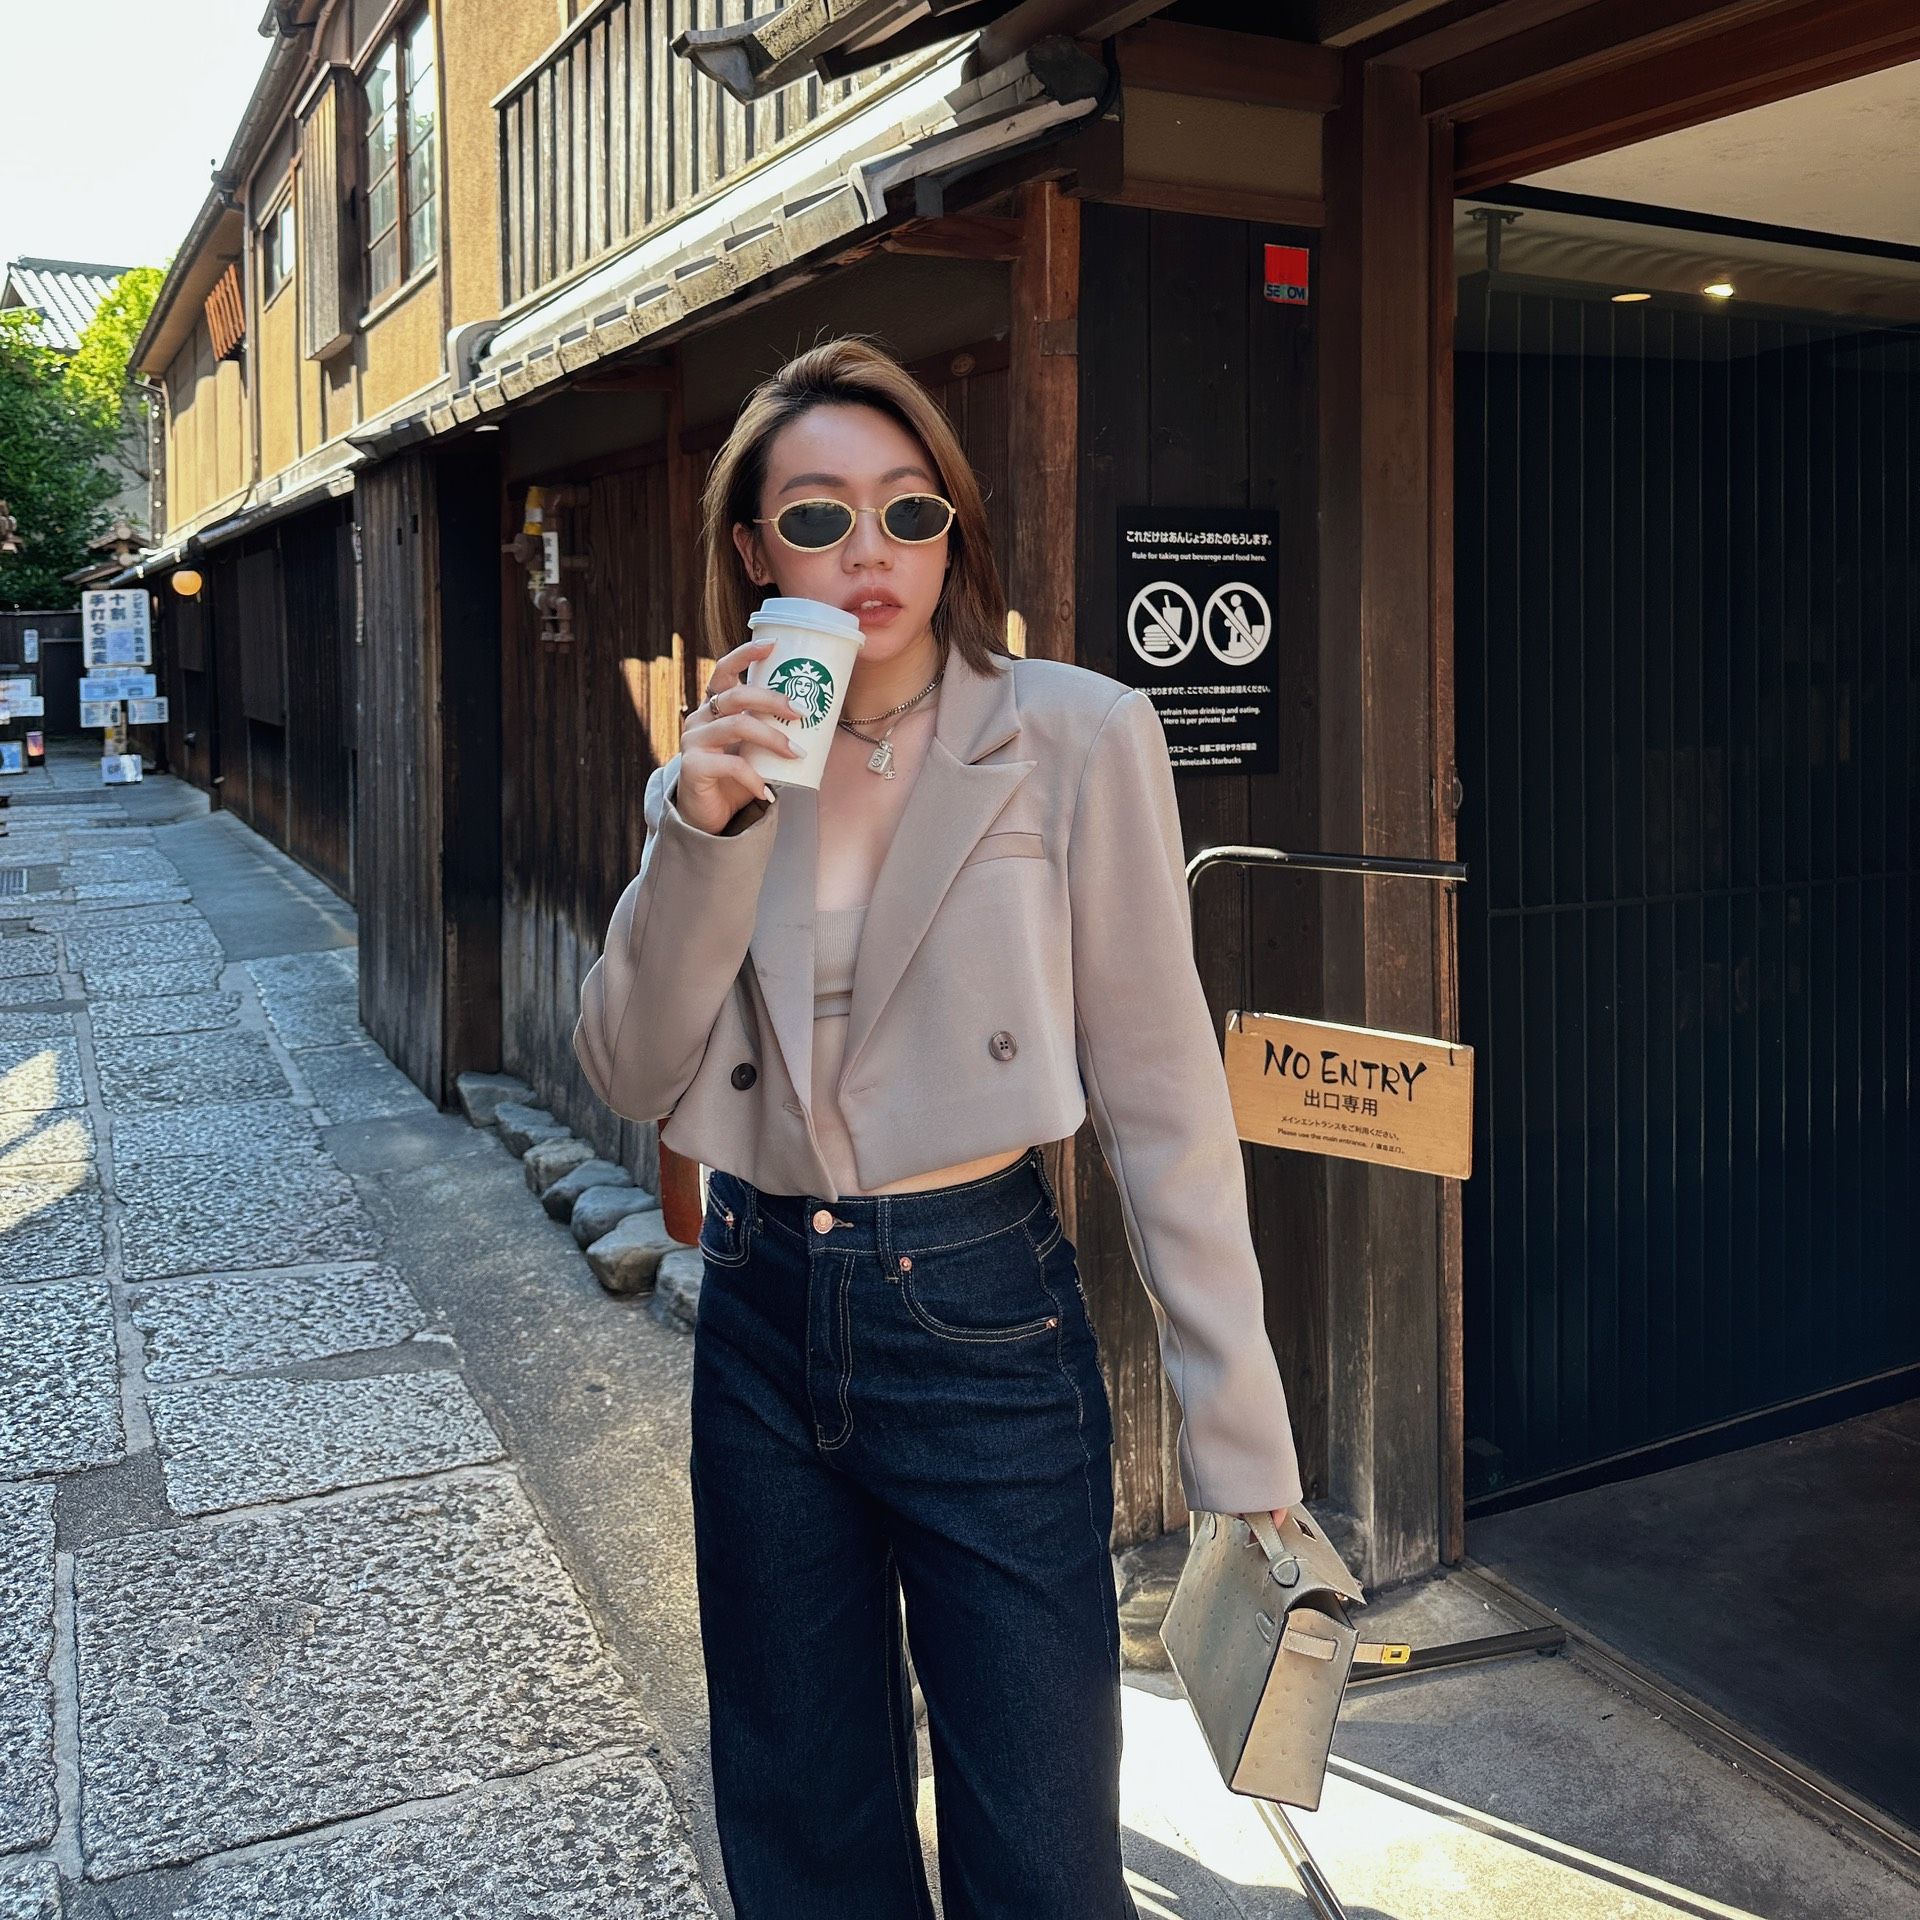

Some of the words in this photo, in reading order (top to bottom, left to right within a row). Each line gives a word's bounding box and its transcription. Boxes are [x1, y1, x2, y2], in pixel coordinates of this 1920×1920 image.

[1126, 531, 1272, 545] これだけはあんじょうおたのもうします。
[1132, 551, 1147, 560] Rule
[1148, 551, 1157, 560] for
[1159, 552, 1179, 562] taking
[1222, 553, 1234, 561] and
[1235, 553, 1250, 562] food
[1160, 707, 1182, 716] refrain
[1183, 707, 1199, 715] from
[1199, 706, 1226, 716] drinking
[1226, 706, 1239, 714] and
[1163, 717, 1179, 725] Here
[1179, 716, 1186, 725] is
[1198, 716, 1221, 726] private
[1211, 756, 1242, 766] Starbucks
[1264, 1039, 1311, 1080] NO
[1304, 1089, 1378, 1117] 出口専用
[1277, 1127, 1297, 1137] Please
[1310, 1132, 1322, 1141] the
[1322, 1135, 1338, 1143] main
[1281, 1116, 1400, 1141] メインエントランスをご利用ください。
